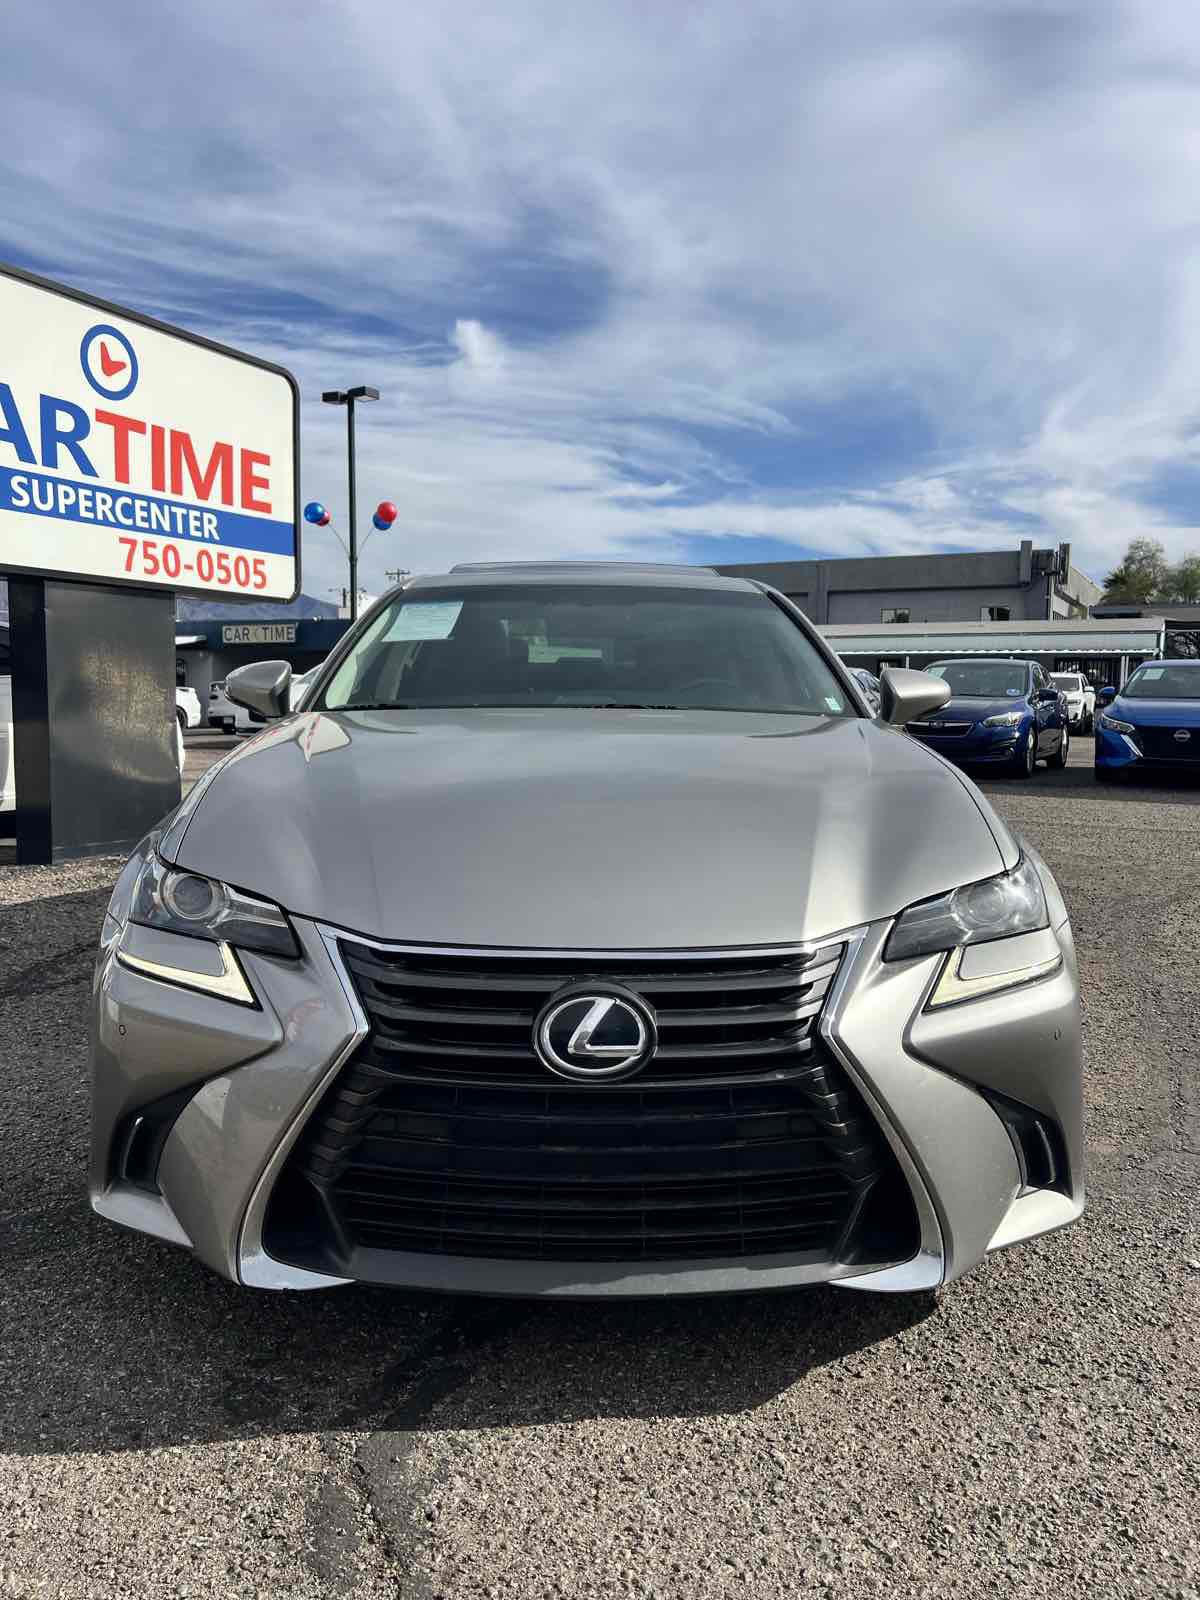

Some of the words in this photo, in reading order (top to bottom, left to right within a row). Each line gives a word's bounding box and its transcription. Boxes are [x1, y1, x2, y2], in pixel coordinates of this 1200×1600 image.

[10, 476, 220, 540] SUPERCENTER
[118, 536, 267, 589] 750-0505
[224, 627, 250, 641] CAR
[262, 626, 295, 641] TIME
